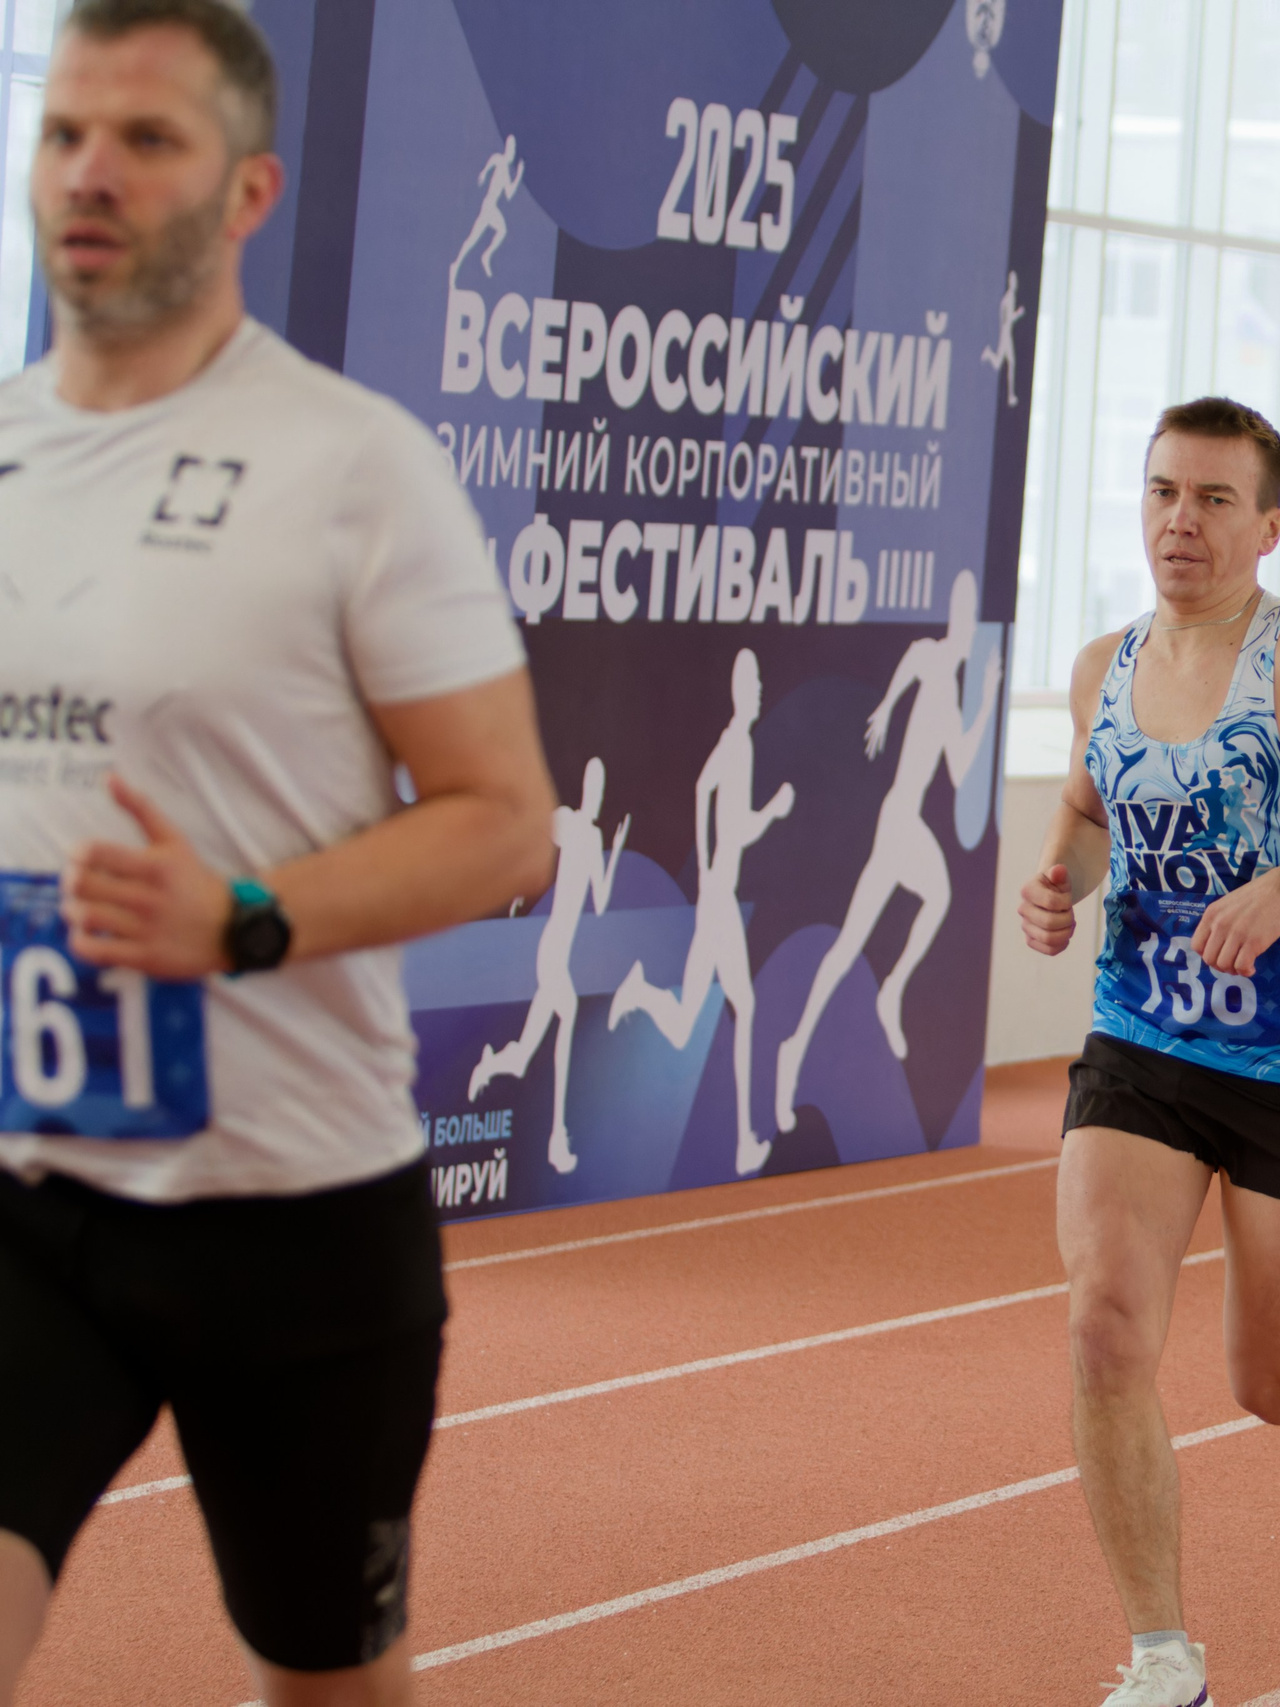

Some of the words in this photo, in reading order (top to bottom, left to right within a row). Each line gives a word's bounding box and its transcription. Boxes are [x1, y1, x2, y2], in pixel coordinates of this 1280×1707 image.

[656, 97, 798, 252] 2025
[440, 288, 952, 430] ВСЕРОССИЙСКИЙ
[624, 435, 943, 510] КОРПОРАТИВНЫЙ
[508, 513, 869, 625] ФЕСТИВАЛЬ
[1115, 802, 1218, 851] IVA
[1126, 850, 1261, 896] NOV
[1137, 932, 1258, 1026] 138
[0, 942, 155, 1109] 61
[433, 1108, 513, 1147] БОЛЬШЕ
[430, 1146, 508, 1208] ИРУЙ
